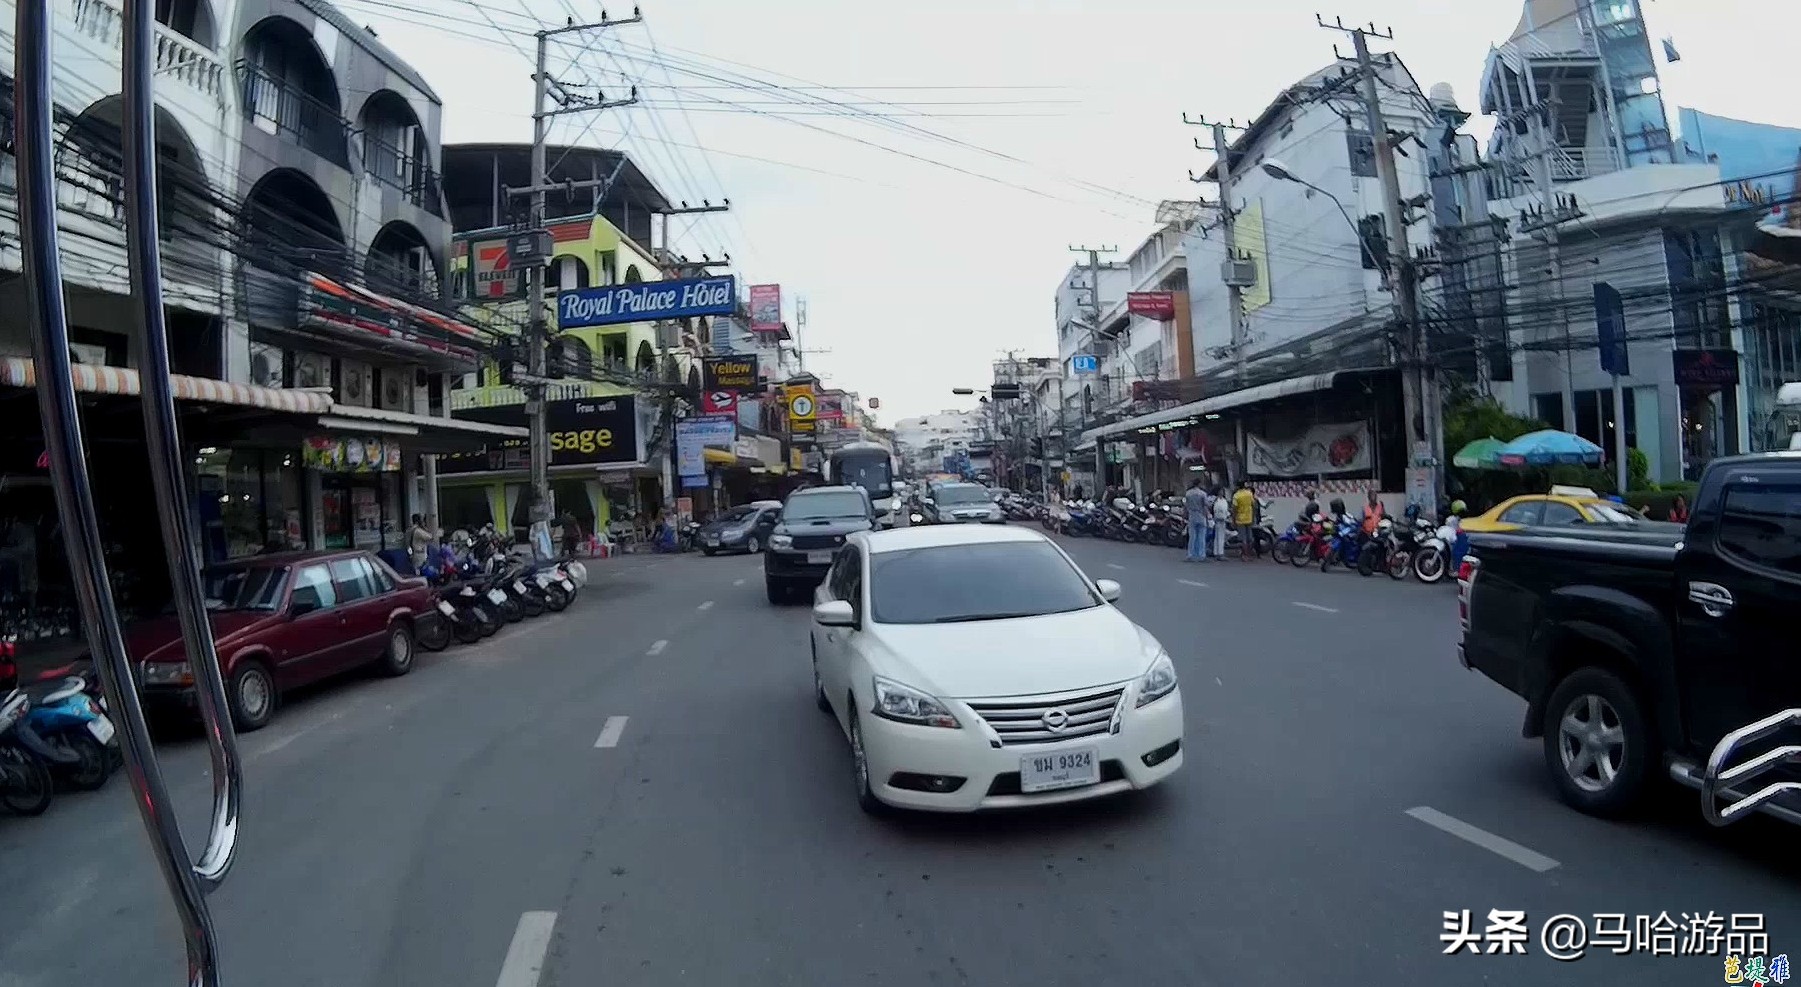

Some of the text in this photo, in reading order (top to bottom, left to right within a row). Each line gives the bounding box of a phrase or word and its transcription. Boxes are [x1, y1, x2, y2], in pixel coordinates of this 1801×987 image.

[561, 290, 613, 321] Royal
[616, 286, 677, 314] Palace
[709, 361, 751, 375] Yellow
[1059, 752, 1091, 769] 9324
